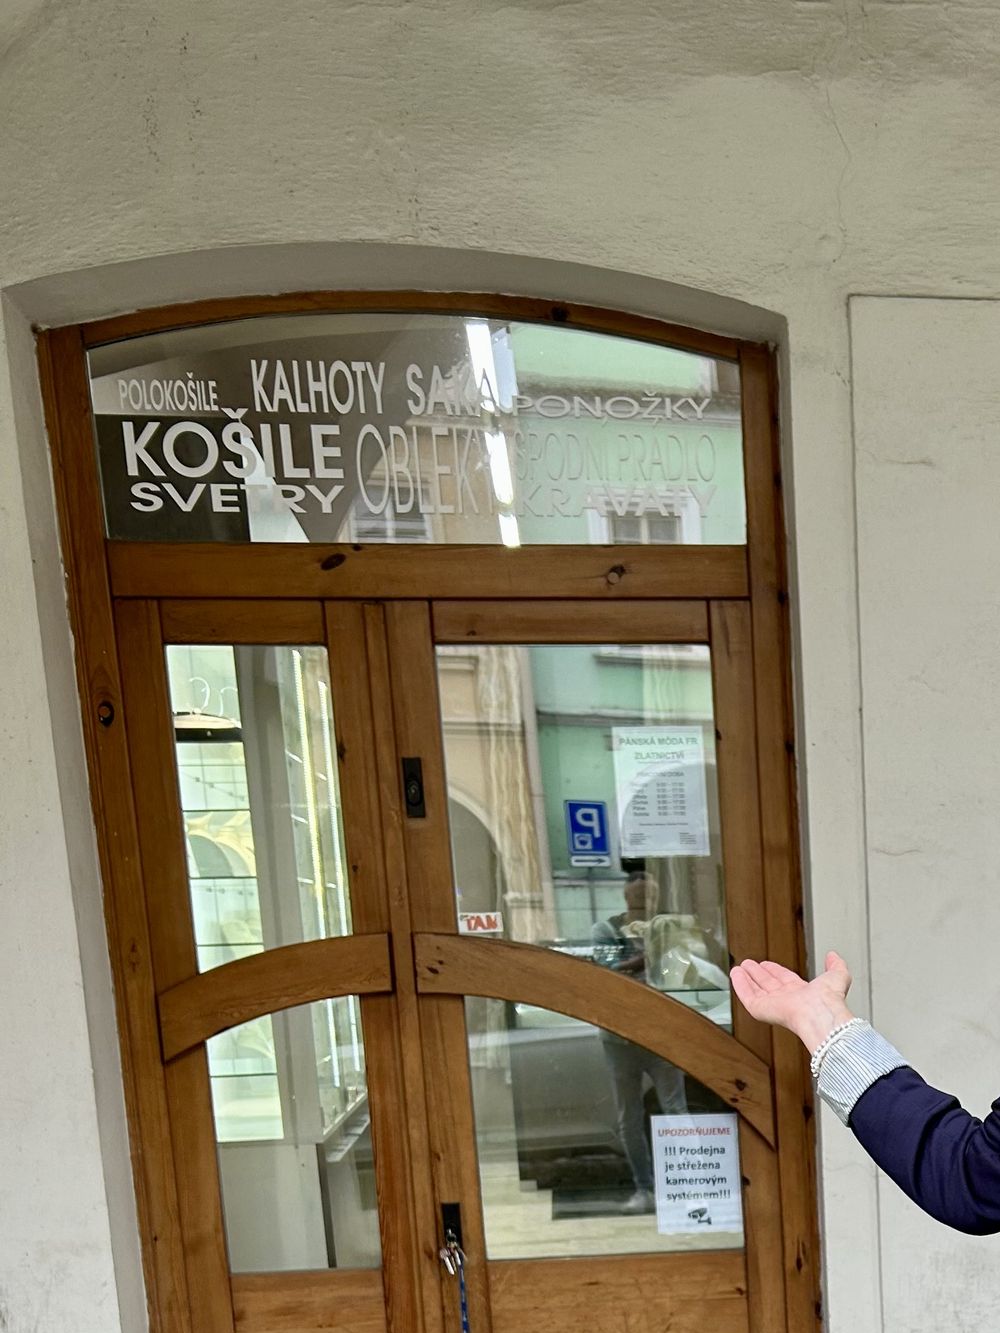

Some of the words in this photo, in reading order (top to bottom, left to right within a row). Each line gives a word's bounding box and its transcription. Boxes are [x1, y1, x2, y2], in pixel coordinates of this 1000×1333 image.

[117, 372, 219, 412] POLOKOŠILE
[250, 359, 386, 414] KALHOTY
[405, 363, 499, 416] SAKA
[511, 390, 712, 420] PONOŽKY
[121, 407, 345, 479] KOŠILE
[130, 482, 345, 514] SVETRY
[517, 484, 717, 518] KRAVATY
[664, 1161, 675, 1172] je
[677, 1160, 721, 1171] střežena
[679, 1145, 726, 1157] Prodejna
[666, 1174, 728, 1187] kamerovým
